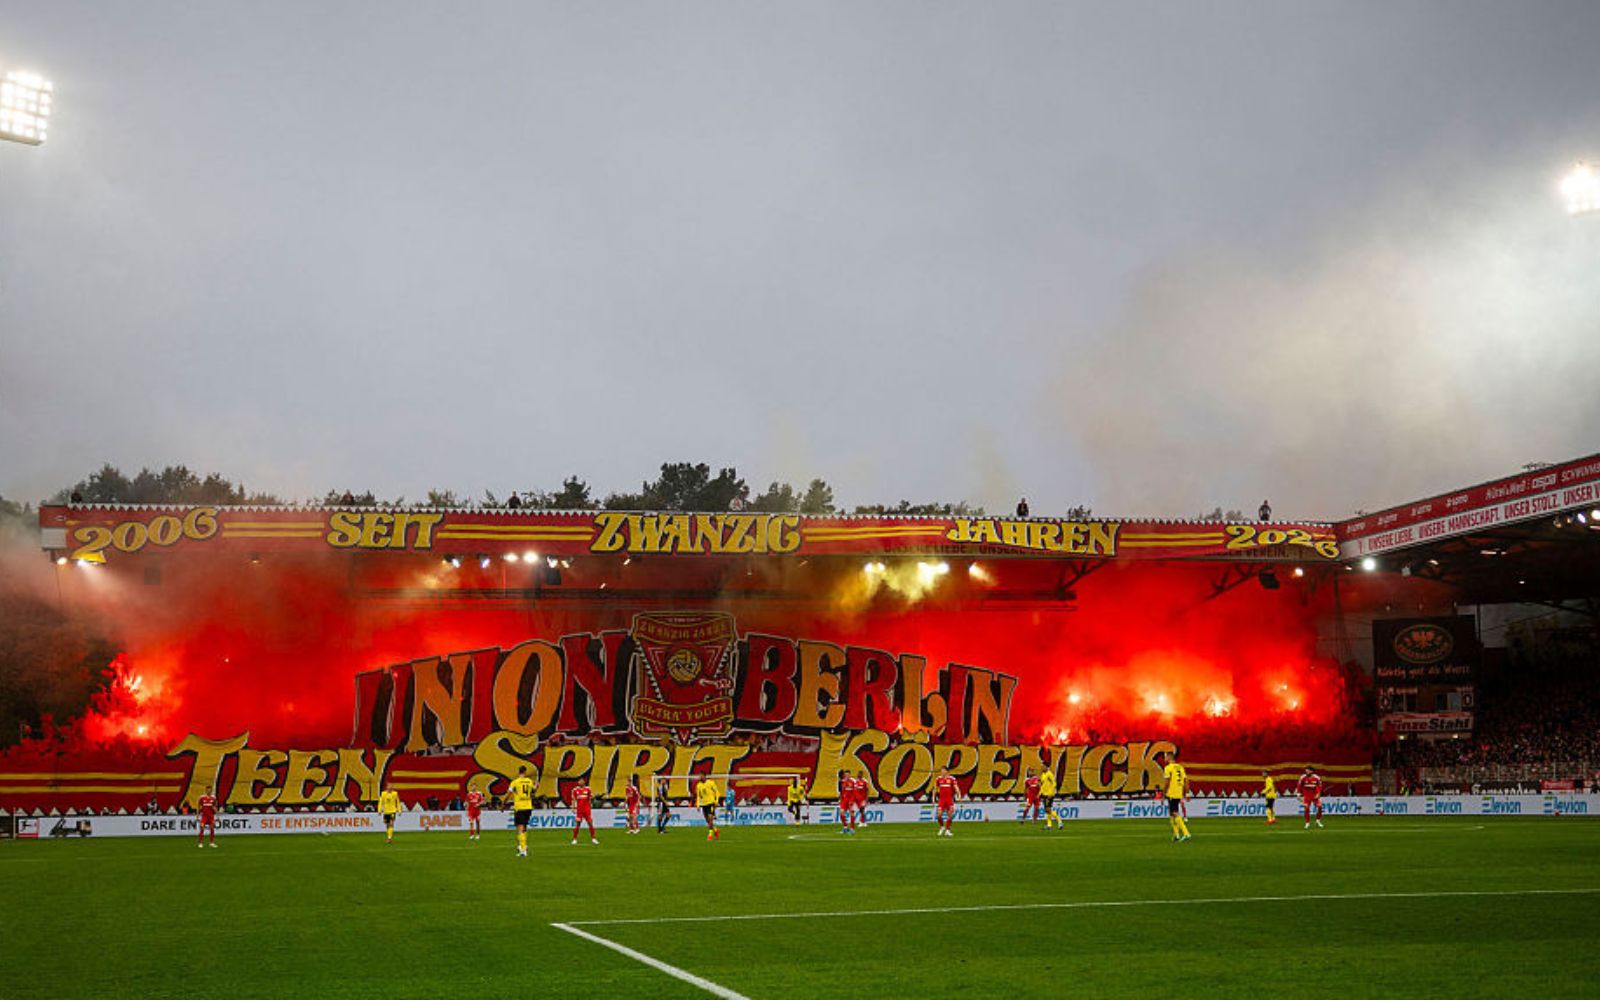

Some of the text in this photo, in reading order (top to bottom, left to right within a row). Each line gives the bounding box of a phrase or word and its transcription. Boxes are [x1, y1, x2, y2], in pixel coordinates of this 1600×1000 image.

[1504, 500, 1530, 519] UNSER
[1563, 484, 1593, 505] UNSER
[70, 506, 1339, 563] 2006 SEIT ZWANZIG JAHREN 2026
[351, 631, 1018, 753] UNION BERLIN
[166, 729, 1177, 808] TEEN SPIRIT KÖPENICK
[141, 819, 176, 831] DARE
[260, 818, 282, 829] SIE
[286, 816, 373, 829] ENTSPANNEN.
[419, 815, 462, 827] DARE
